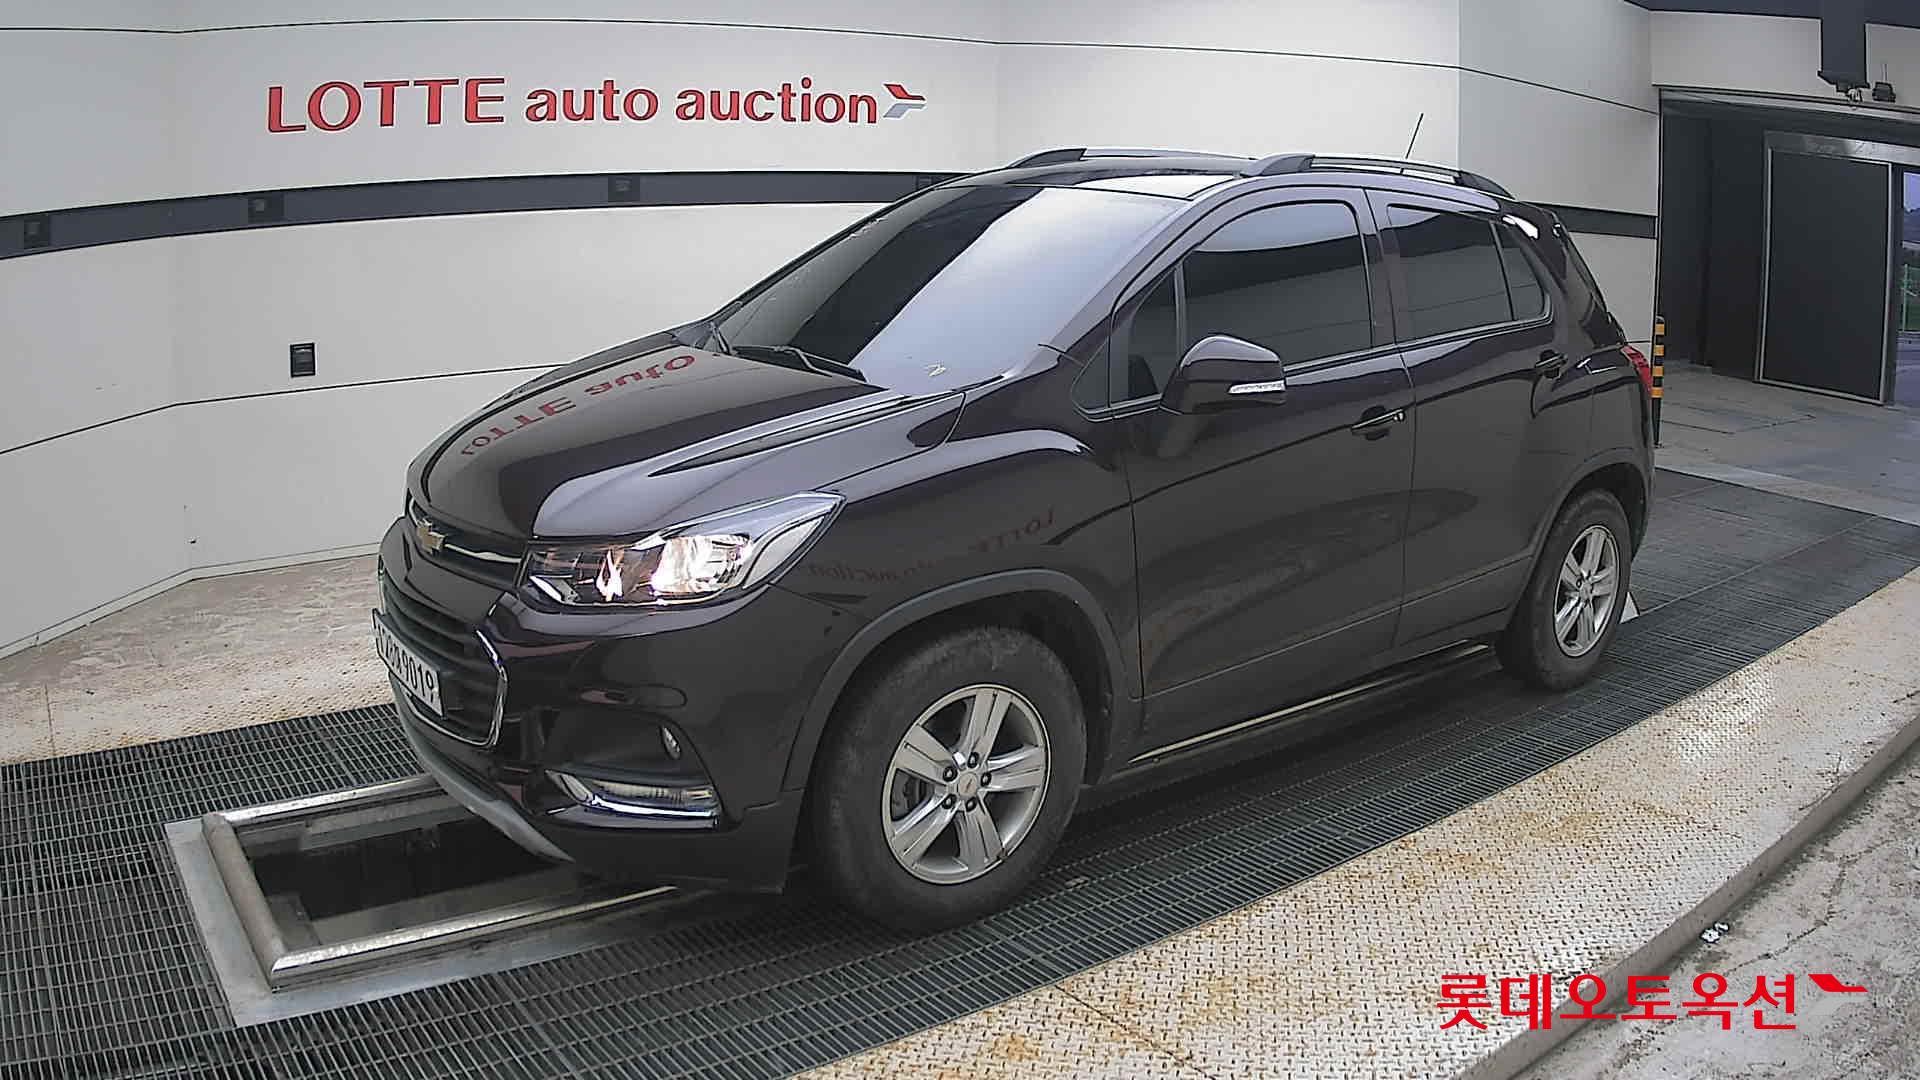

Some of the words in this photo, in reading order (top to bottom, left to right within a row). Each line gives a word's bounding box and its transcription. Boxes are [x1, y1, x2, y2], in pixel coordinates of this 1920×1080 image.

[267, 78, 505, 133] LOTTE
[526, 79, 658, 122] auto
[675, 77, 878, 124] auction
